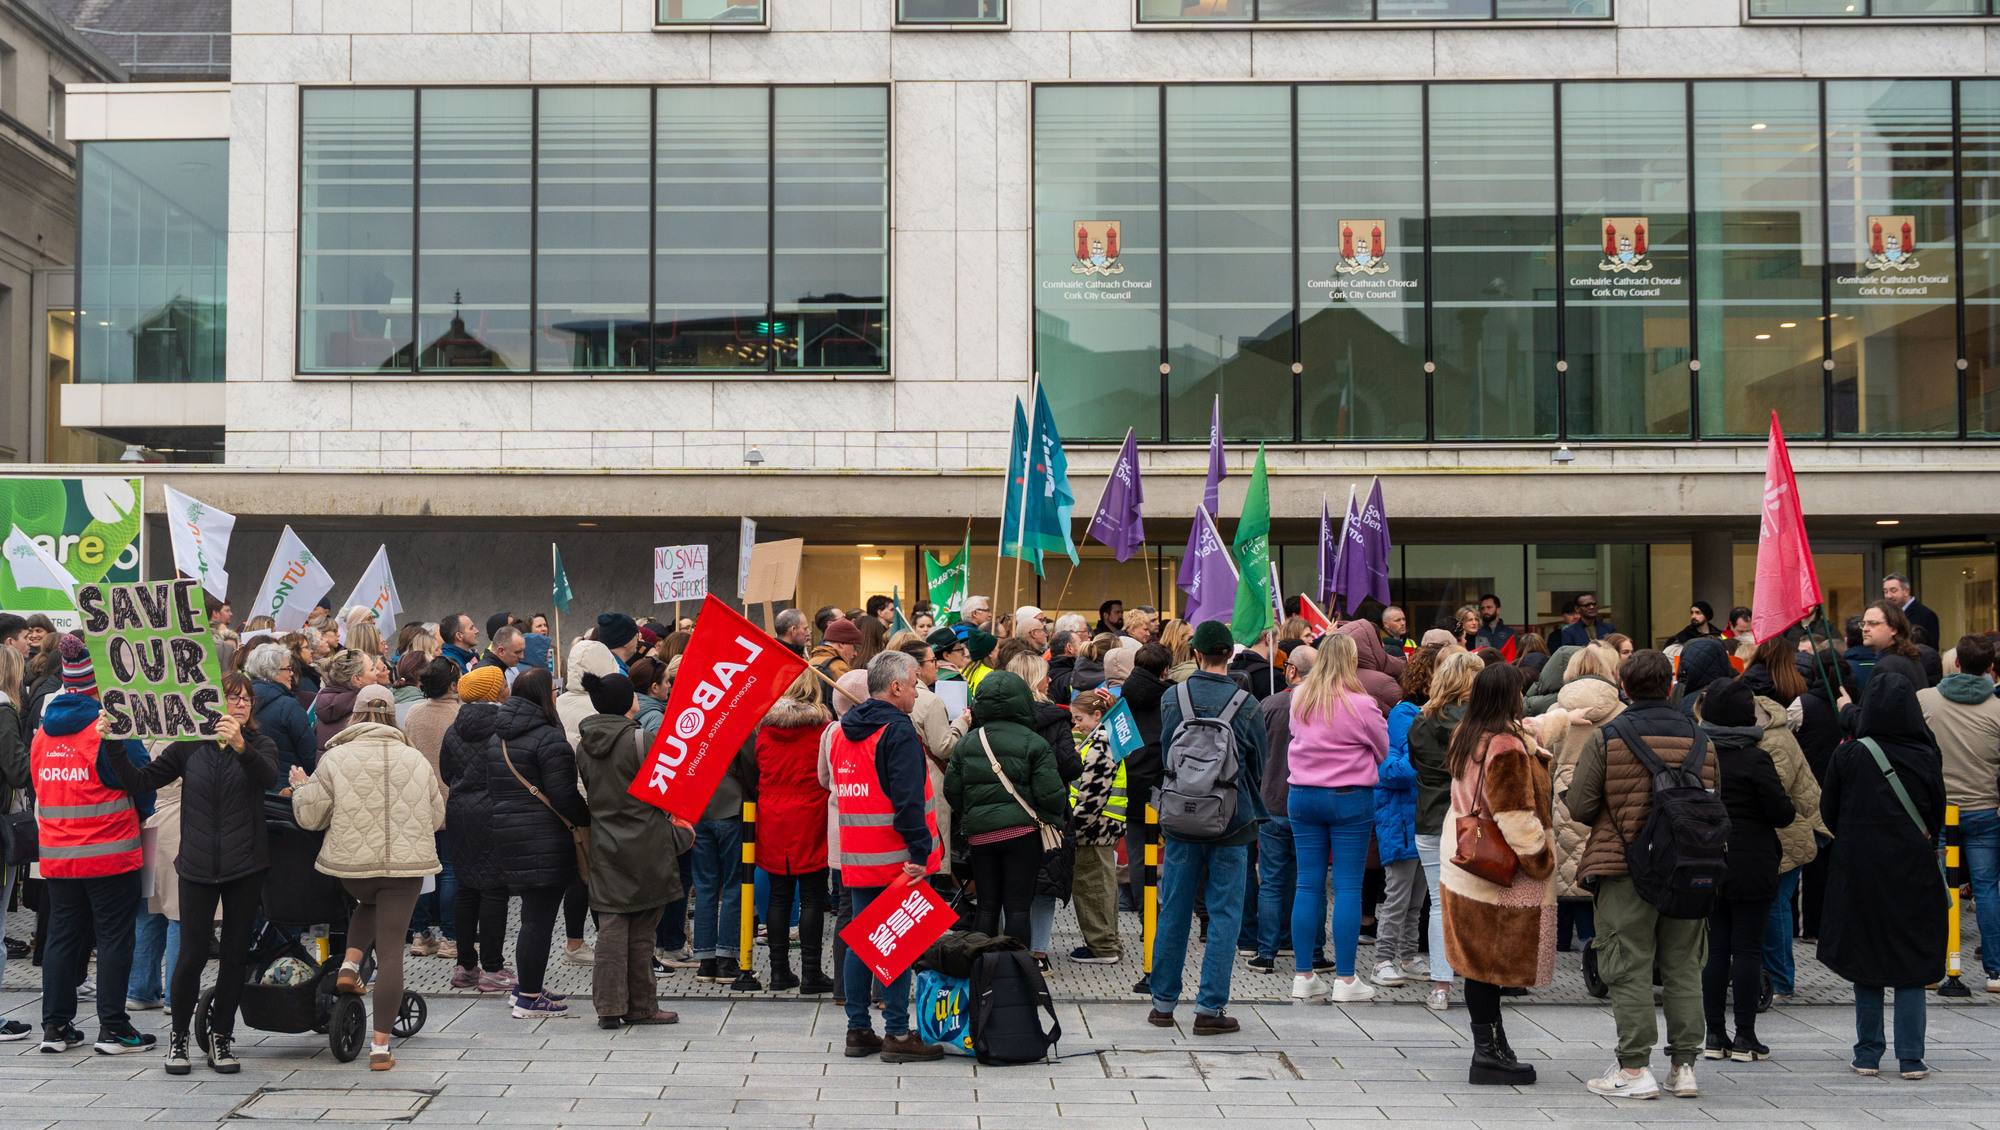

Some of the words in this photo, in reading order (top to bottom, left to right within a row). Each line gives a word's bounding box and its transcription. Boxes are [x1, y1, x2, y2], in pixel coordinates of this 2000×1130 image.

[1042, 280, 1083, 289] Comhairle
[1085, 280, 1120, 289] Cathrach
[1307, 280, 1348, 288] Comhairle
[1350, 280, 1385, 288] Cathrach
[1387, 279, 1418, 288] Chorcaí
[1570, 278, 1611, 286] Comhairle
[1613, 277, 1649, 286] Cathrach
[1837, 276, 1879, 284] Comhairle
[1880, 276, 1916, 284] Cathrach
[1064, 291, 1082, 300] Cork
[1084, 291, 1099, 300] City
[1101, 291, 1131, 300] Council
[1329, 291, 1348, 299] Cork
[1349, 291, 1364, 299] City
[1366, 290, 1396, 298] Council
[1592, 288, 1611, 296] Cork
[1612, 288, 1628, 297] City
[1629, 288, 1660, 296] Council
[1859, 287, 1878, 295] Cork
[1880, 287, 1895, 296] City
[1896, 286, 1927, 295] Council
[655, 549, 674, 570] NO
[78, 580, 205, 634] SAVE
[109, 636, 207, 684] OUR
[103, 688, 223, 736] SNAS
[902, 890, 934, 924] SAVE
[886, 908, 914, 938] OUR
